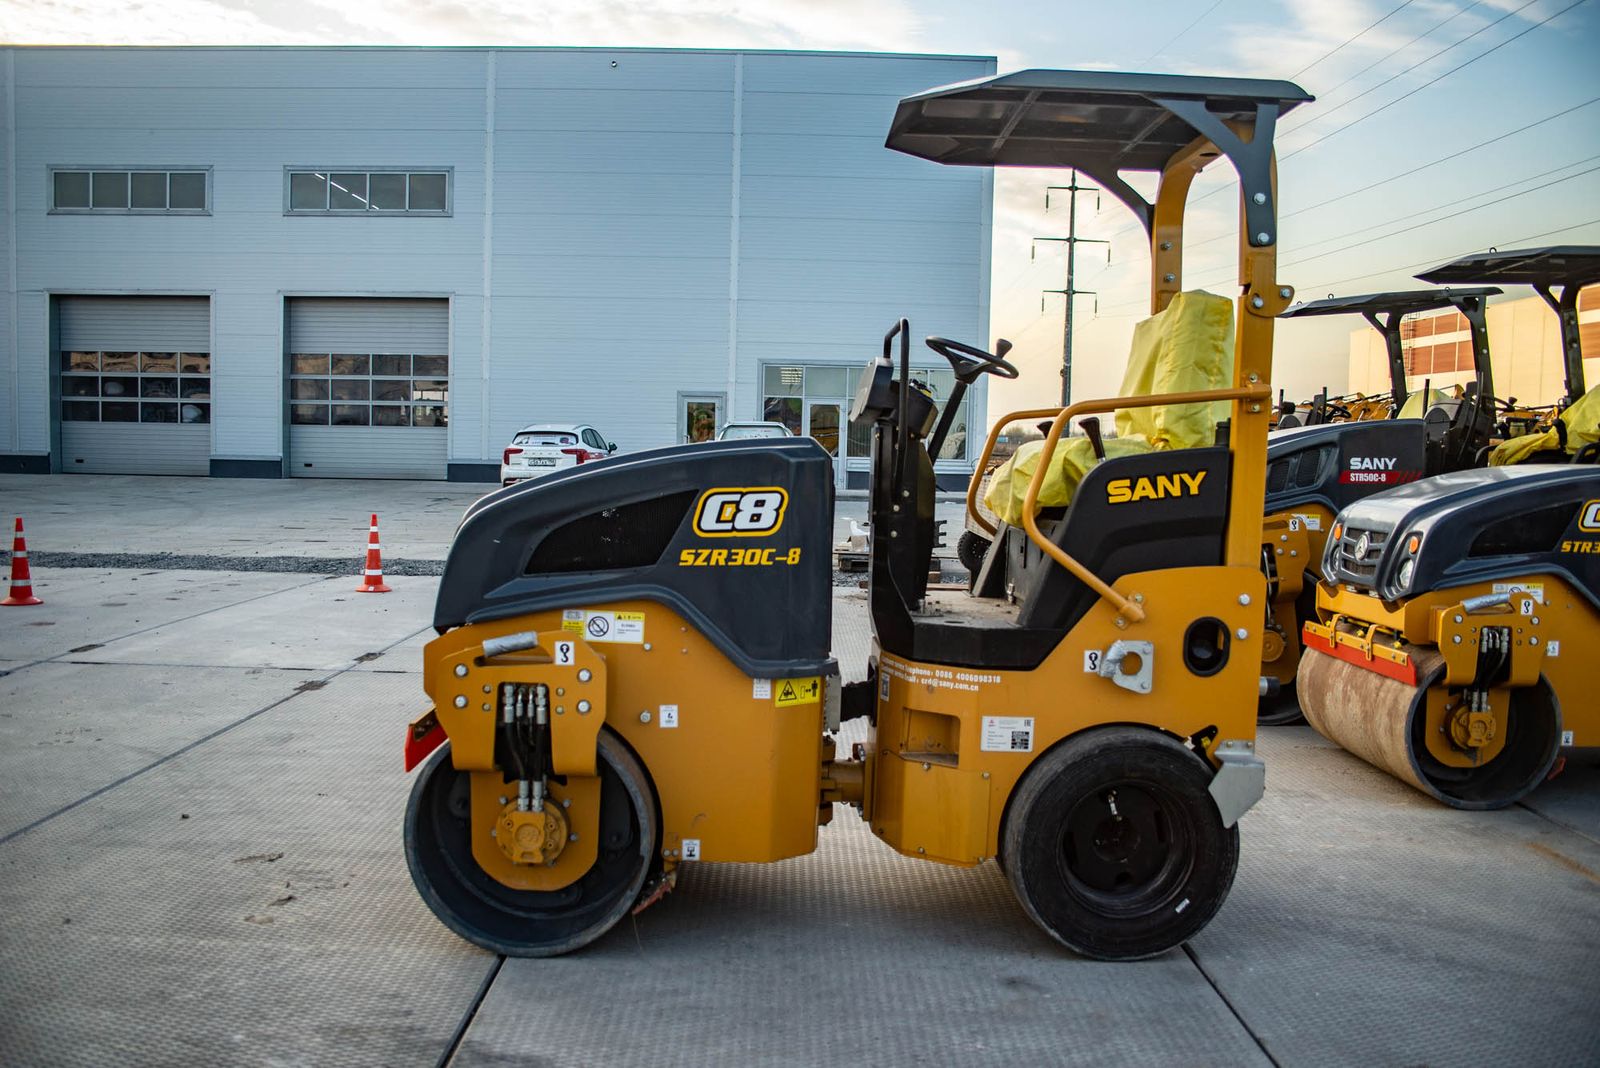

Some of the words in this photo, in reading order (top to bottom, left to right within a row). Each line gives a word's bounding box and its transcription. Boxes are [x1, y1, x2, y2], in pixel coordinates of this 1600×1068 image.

[1350, 457, 1397, 470] SANY
[1350, 472, 1386, 482] STR50C-8
[1107, 471, 1207, 504] SANY
[697, 490, 785, 534] C8
[679, 547, 801, 567] SZR30C-8
